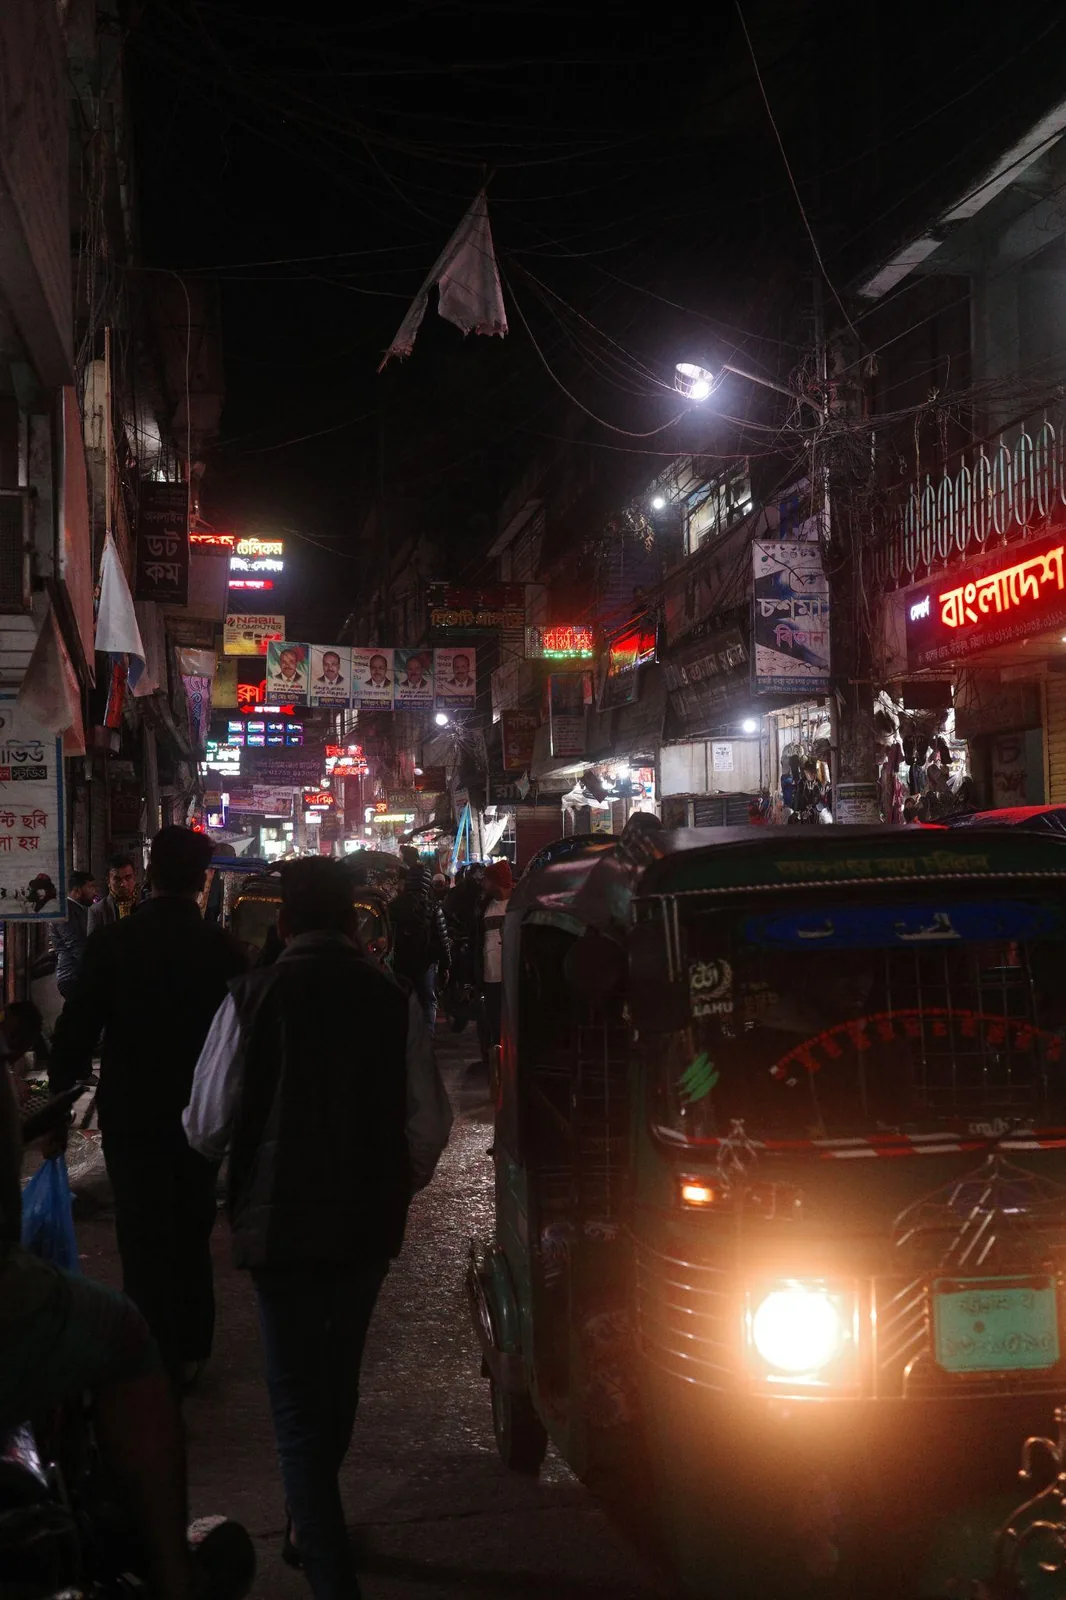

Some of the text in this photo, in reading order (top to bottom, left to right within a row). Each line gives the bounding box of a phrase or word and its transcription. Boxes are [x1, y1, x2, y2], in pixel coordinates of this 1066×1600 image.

[145, 527, 181, 557] ডট
[237, 538, 283, 555] টেলিকম
[143, 560, 182, 585] কম
[939, 546, 1065, 627] বাংলাদেশ
[237, 617, 280, 625] NABIL
[756, 597, 828, 622] চশমা
[774, 624, 827, 649] বিতান
[12, 767, 46, 780] স্টুডিও
[20, 809, 48, 830] ছবি
[17, 836, 41, 853] হয়
